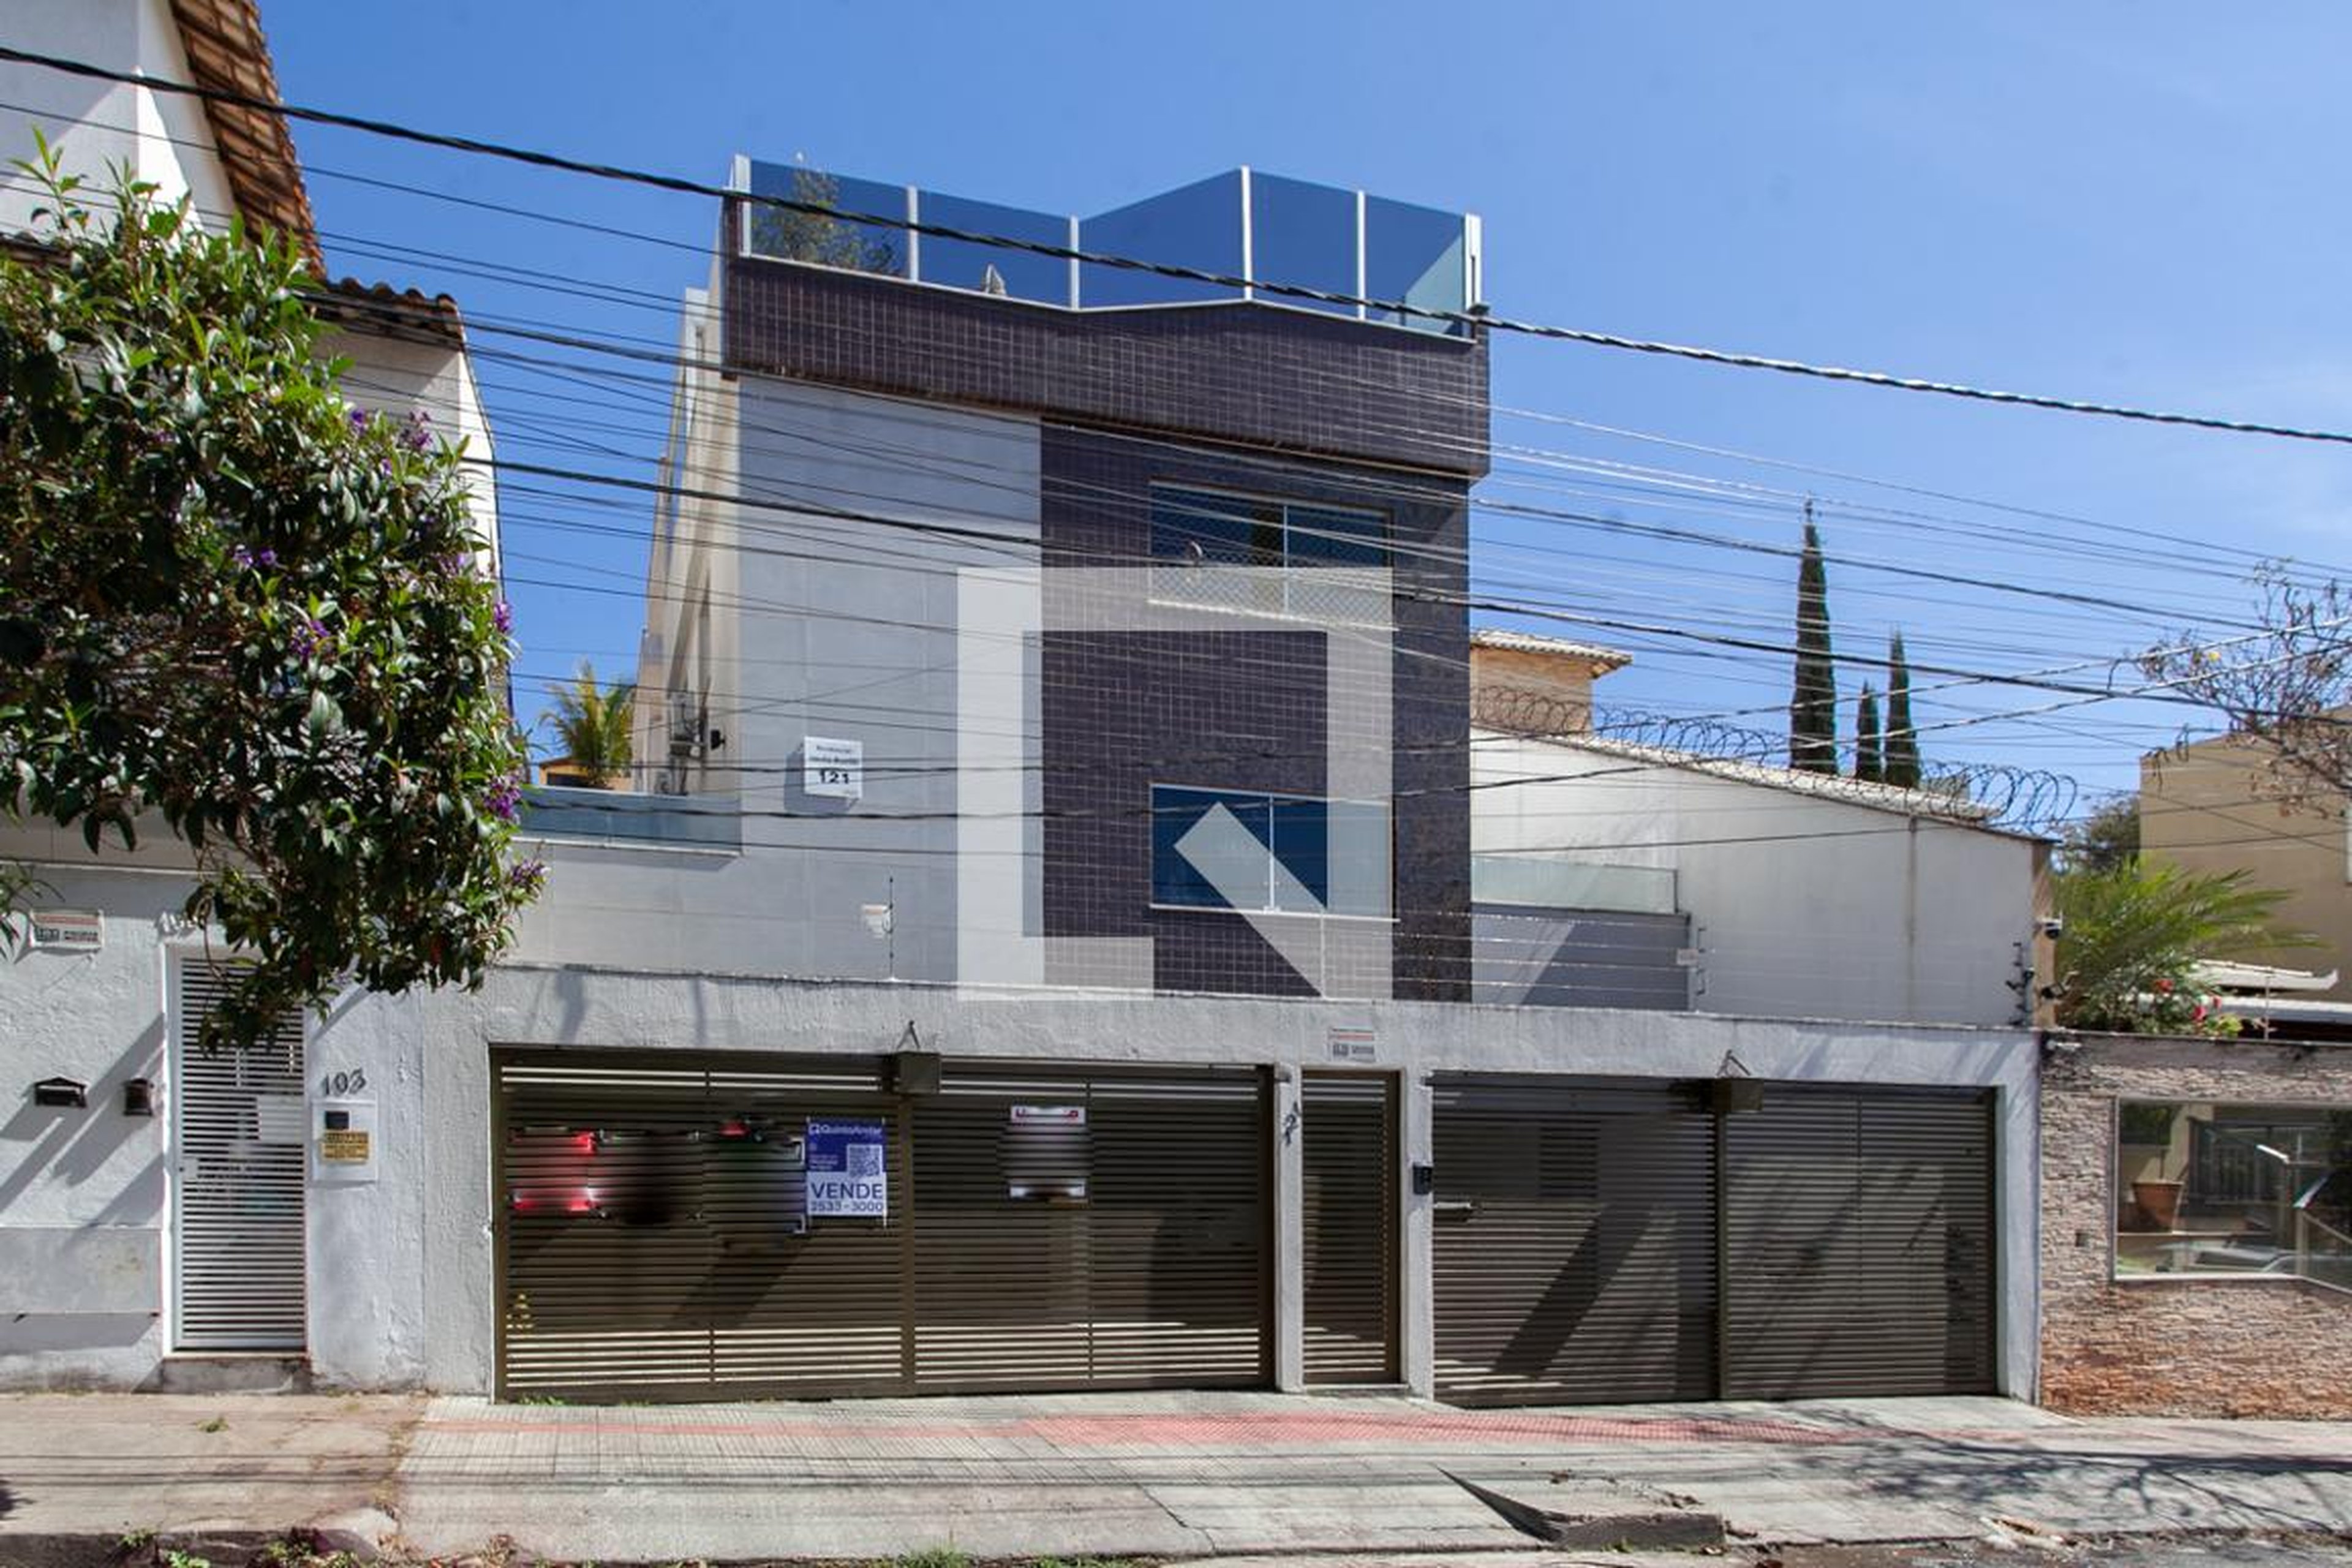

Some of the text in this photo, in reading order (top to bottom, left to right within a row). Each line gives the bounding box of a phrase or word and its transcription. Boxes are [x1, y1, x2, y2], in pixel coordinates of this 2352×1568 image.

[820, 768, 849, 785] 121
[323, 1069, 368, 1096] 103
[810, 1182, 883, 1199] VENDE
